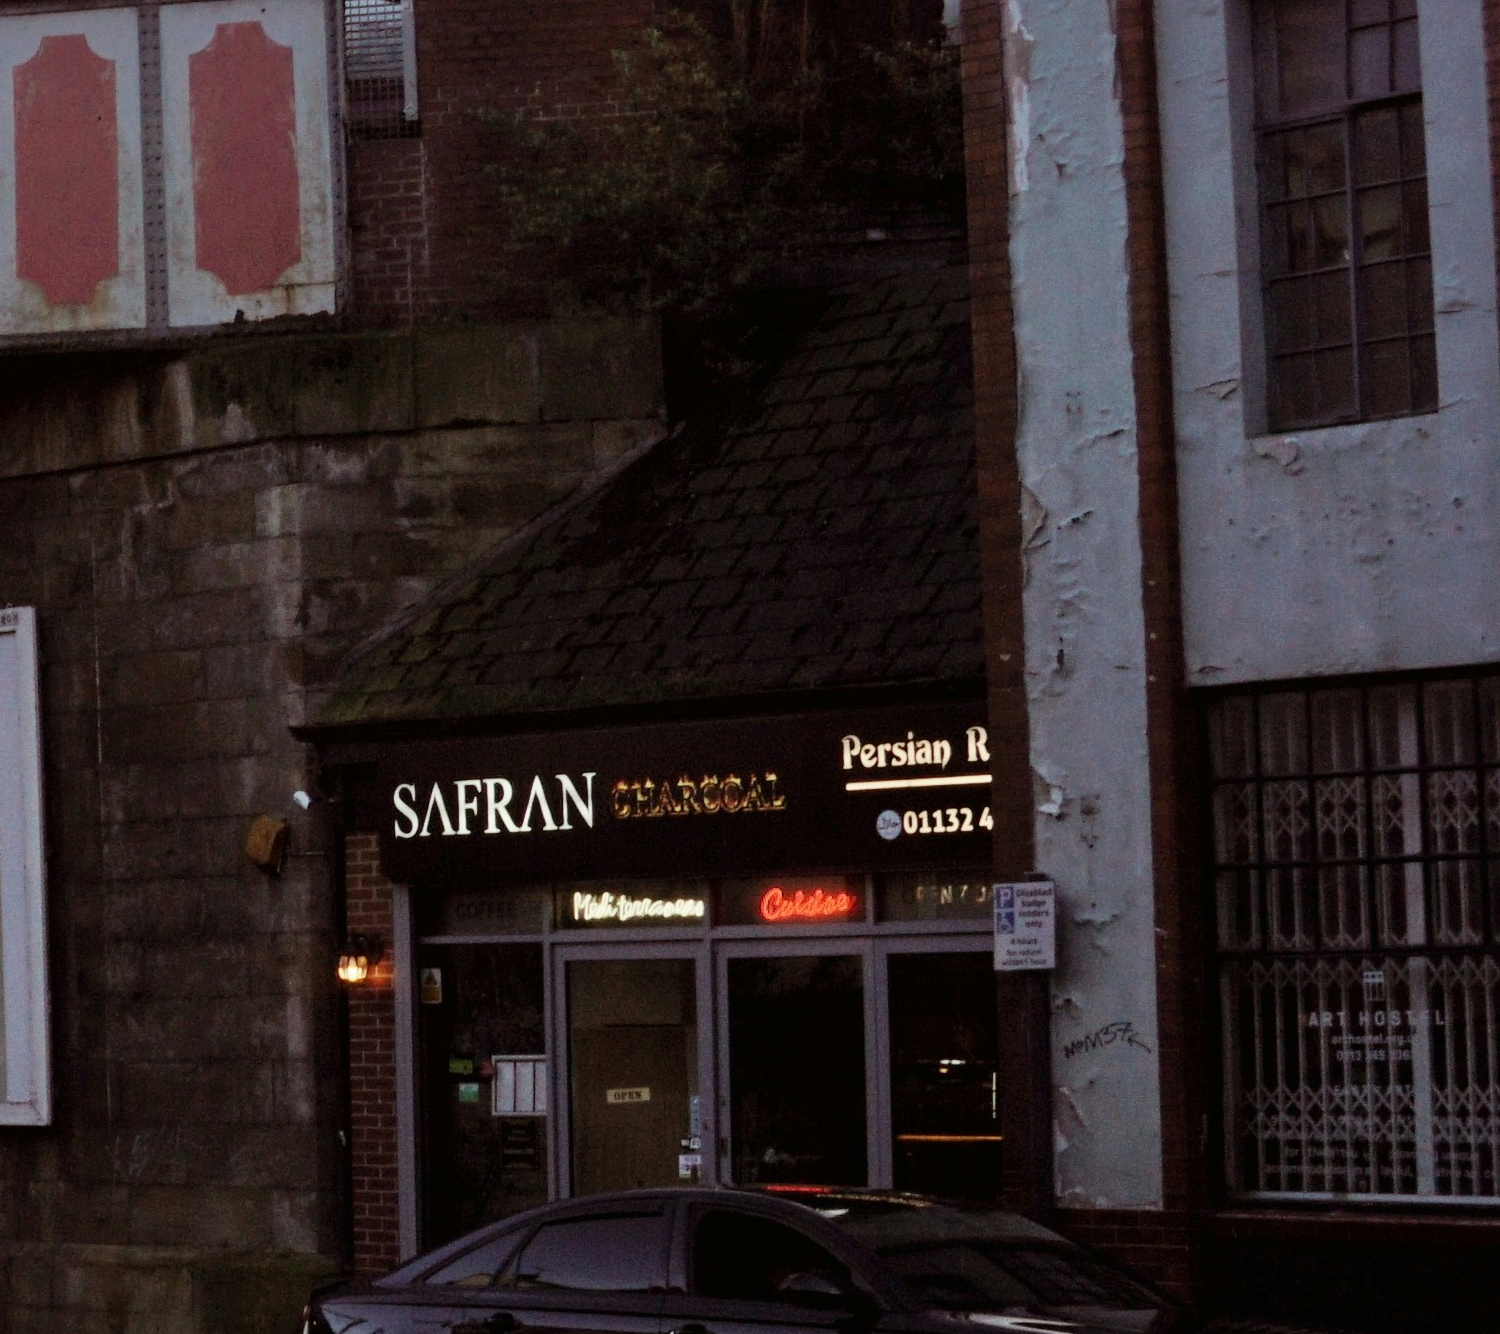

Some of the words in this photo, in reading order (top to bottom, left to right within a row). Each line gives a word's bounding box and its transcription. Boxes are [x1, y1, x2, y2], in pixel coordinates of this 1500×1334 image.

[841, 730, 952, 770] Persian
[393, 771, 597, 839] SAFRAN
[610, 770, 788, 819] CHARCOAL
[613, 1089, 642, 1100] OPEN
